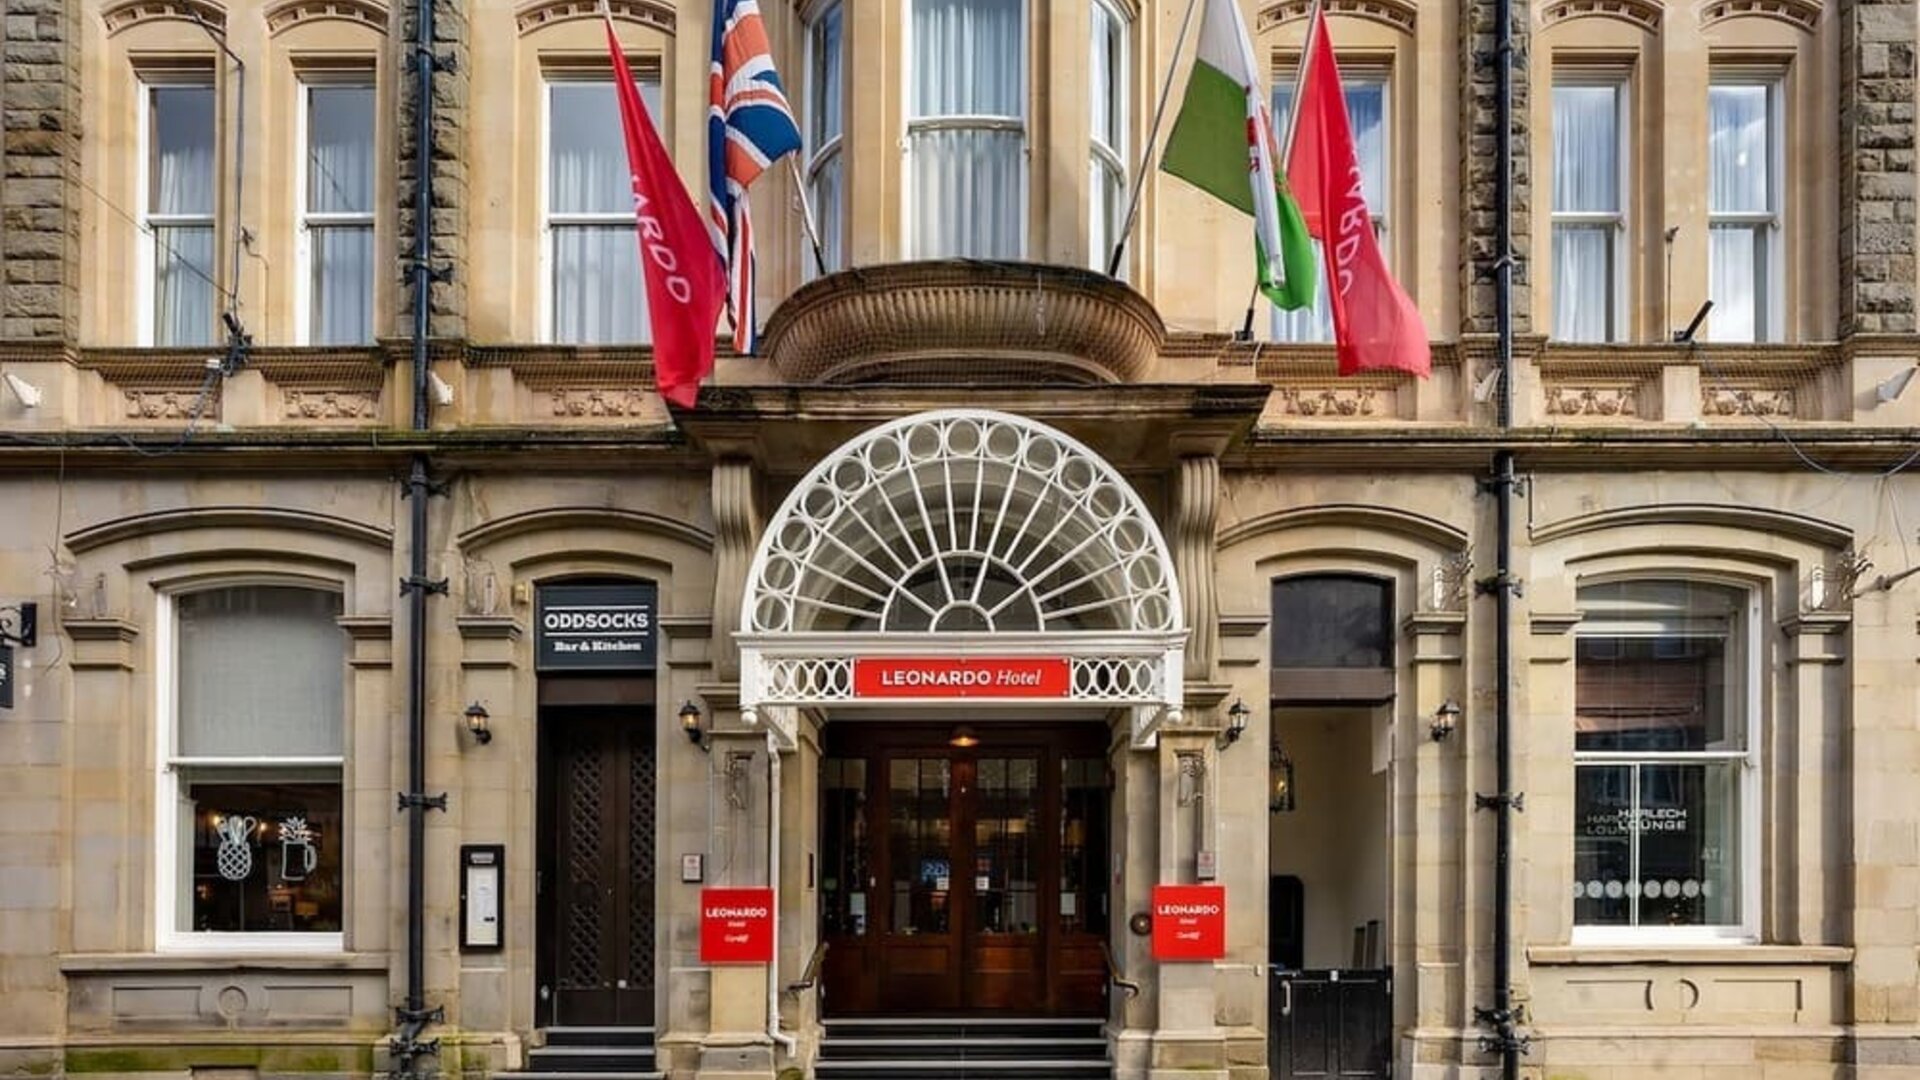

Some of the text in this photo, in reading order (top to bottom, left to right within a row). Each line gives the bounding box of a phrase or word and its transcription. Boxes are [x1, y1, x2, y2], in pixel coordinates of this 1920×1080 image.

[632, 174, 691, 304] ARDO
[544, 612, 649, 629] ODDSOCKS
[553, 640, 642, 652] Bar & Kitchen
[882, 668, 1042, 686] LEONARDO Hotel
[1617, 808, 1687, 818] HARLECH
[1617, 820, 1687, 831] LOUNGE
[705, 907, 767, 918] LEONARDO
[1157, 905, 1219, 915] LEONARDO
